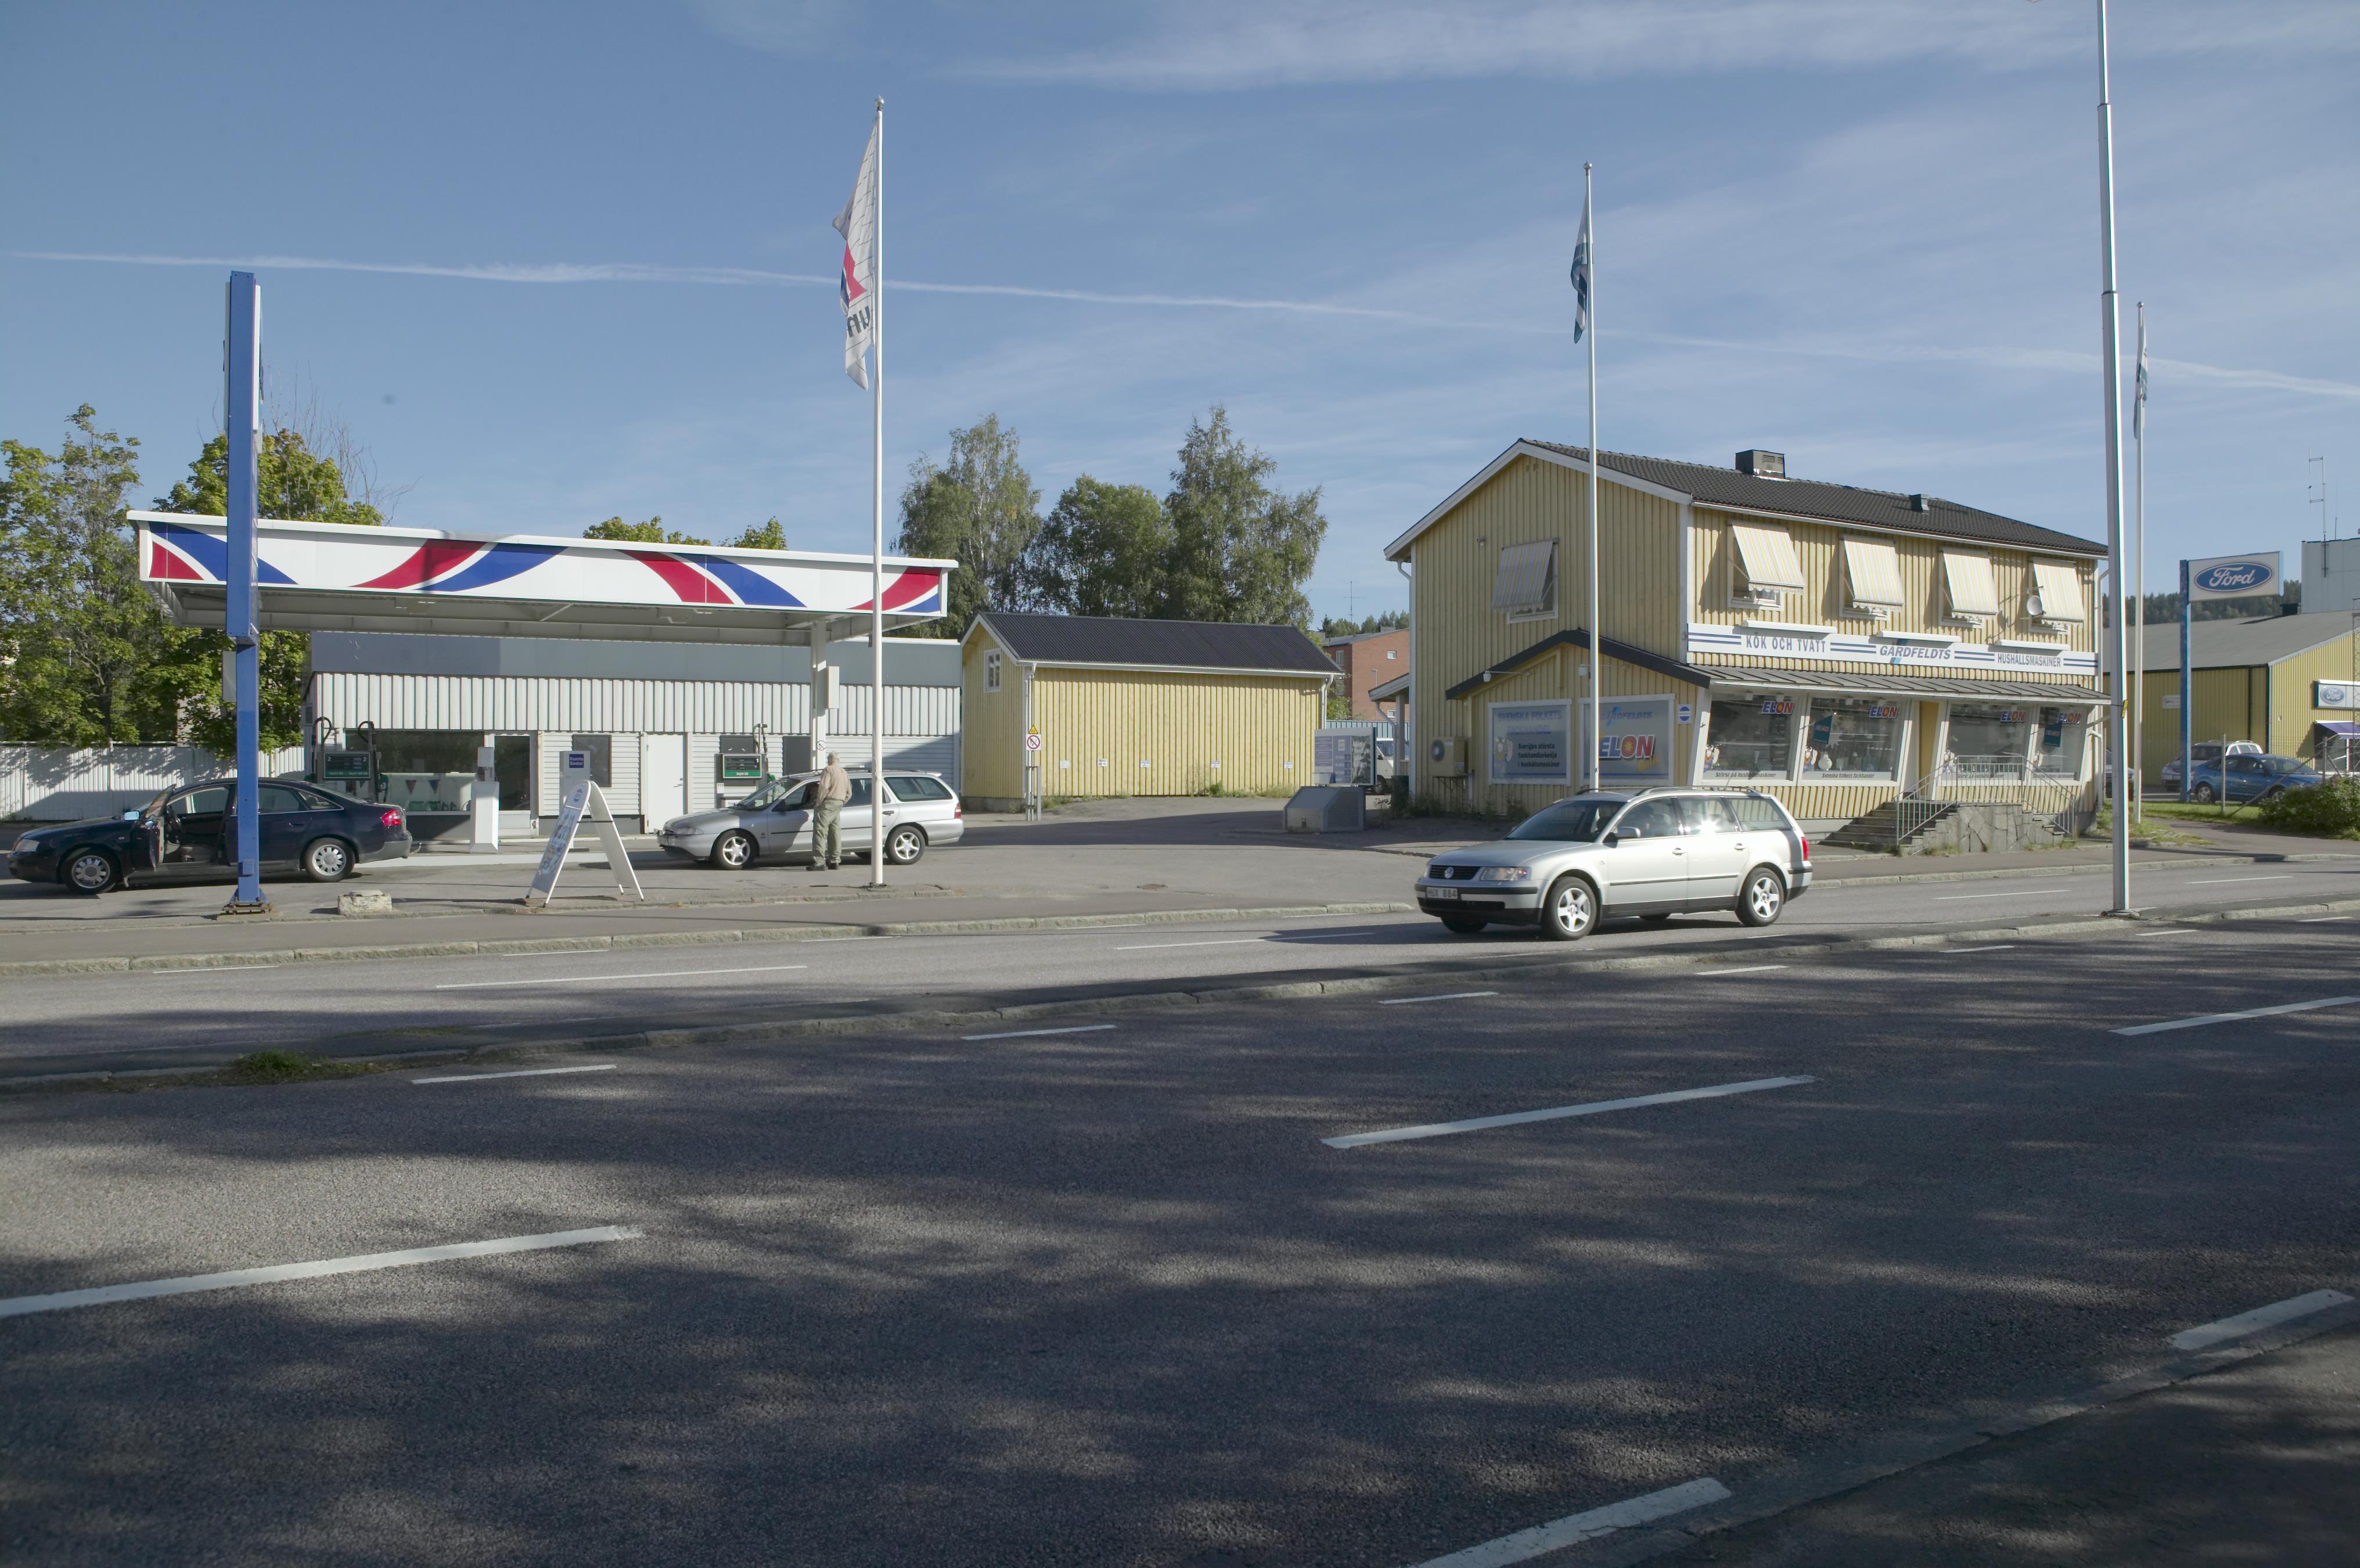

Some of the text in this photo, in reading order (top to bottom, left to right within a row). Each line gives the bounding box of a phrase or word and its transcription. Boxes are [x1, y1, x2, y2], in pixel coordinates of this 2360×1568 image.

[2209, 567, 2255, 587] Ford
[1746, 631, 1825, 652] KÖK OCH TVÄTT
[1880, 642, 1951, 660] GÅRDFELDTS
[1998, 649, 2061, 667] HUSHÅLLSMASKINER
[1498, 710, 1562, 721] SVENSKA FOLKETS
[1762, 700, 1794, 715] ELON
[1869, 705, 1899, 719] ELON
[2000, 710, 2026, 723] ELON
[1598, 734, 1654, 759] ELON
